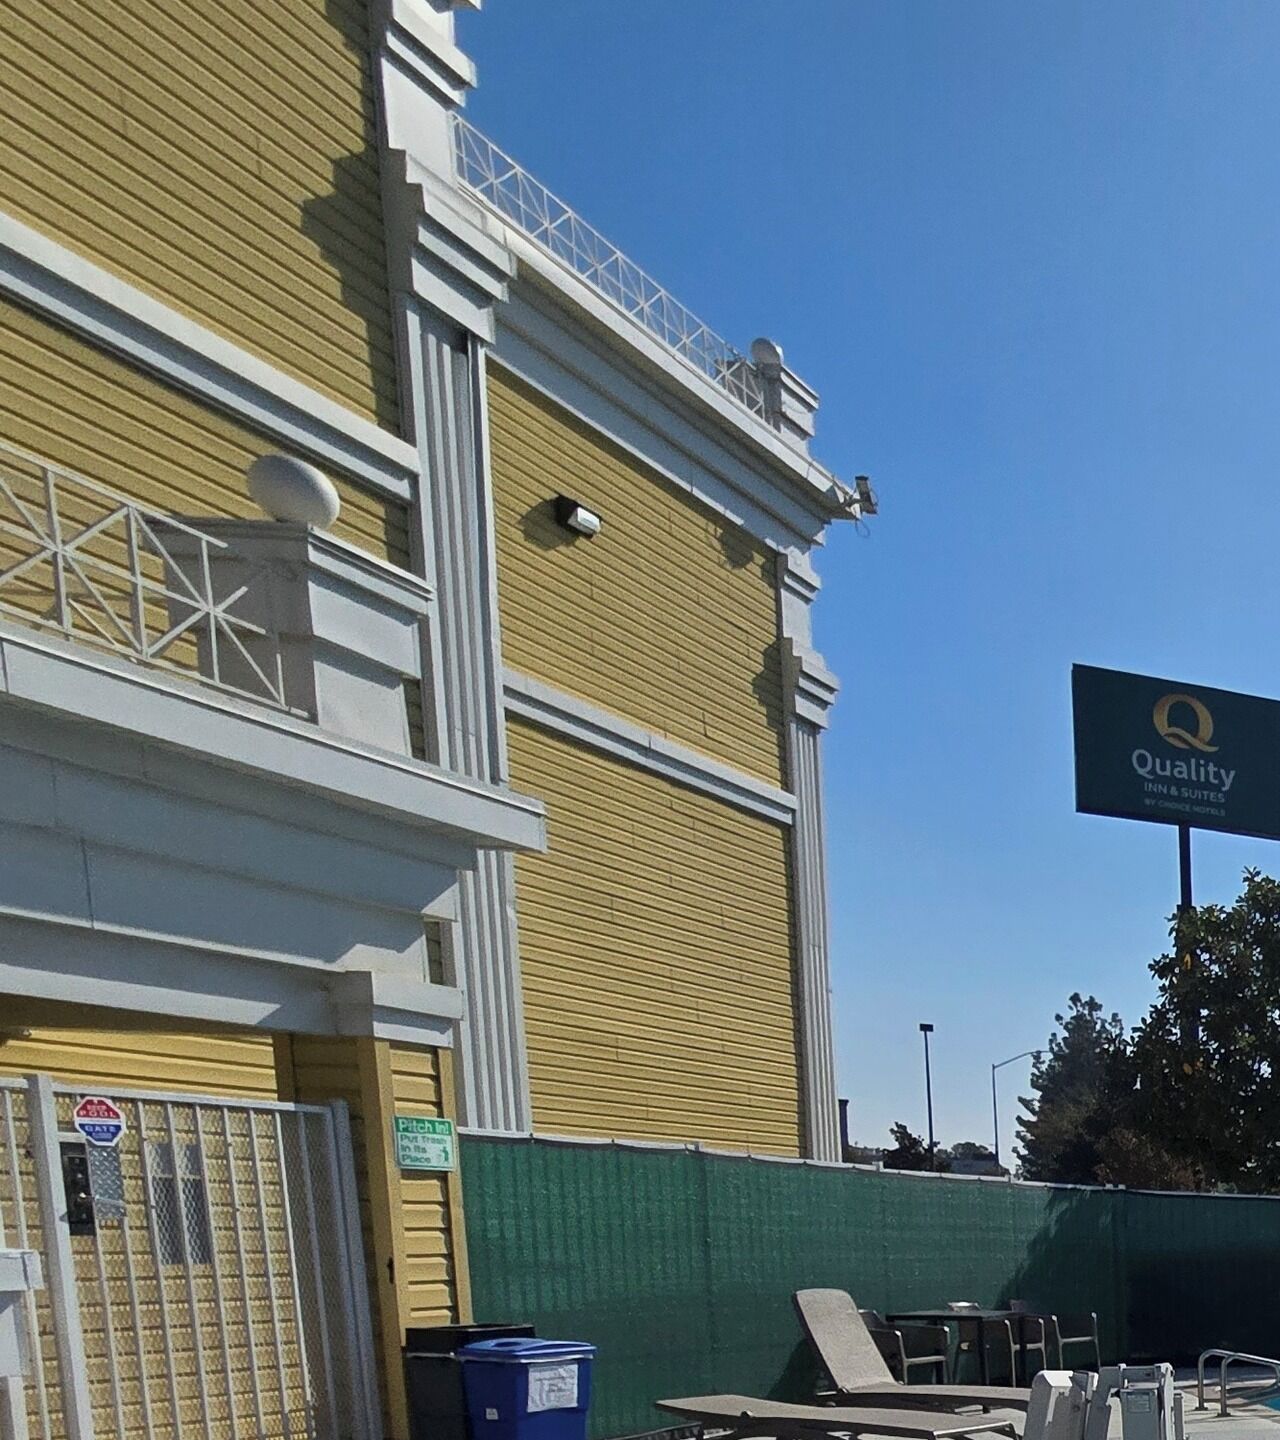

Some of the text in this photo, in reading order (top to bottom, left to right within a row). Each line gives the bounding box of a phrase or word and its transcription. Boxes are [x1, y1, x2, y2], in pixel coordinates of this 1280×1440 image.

[1153, 694, 1219, 752] Q
[1132, 749, 1236, 791] Quality
[1144, 781, 1225, 803] INN & SUITES
[79, 1110, 117, 1118] POOL
[85, 1125, 117, 1133] GATE
[399, 1119, 432, 1133] Pitch
[401, 1134, 418, 1143] Put
[402, 1154, 431, 1164] Place
